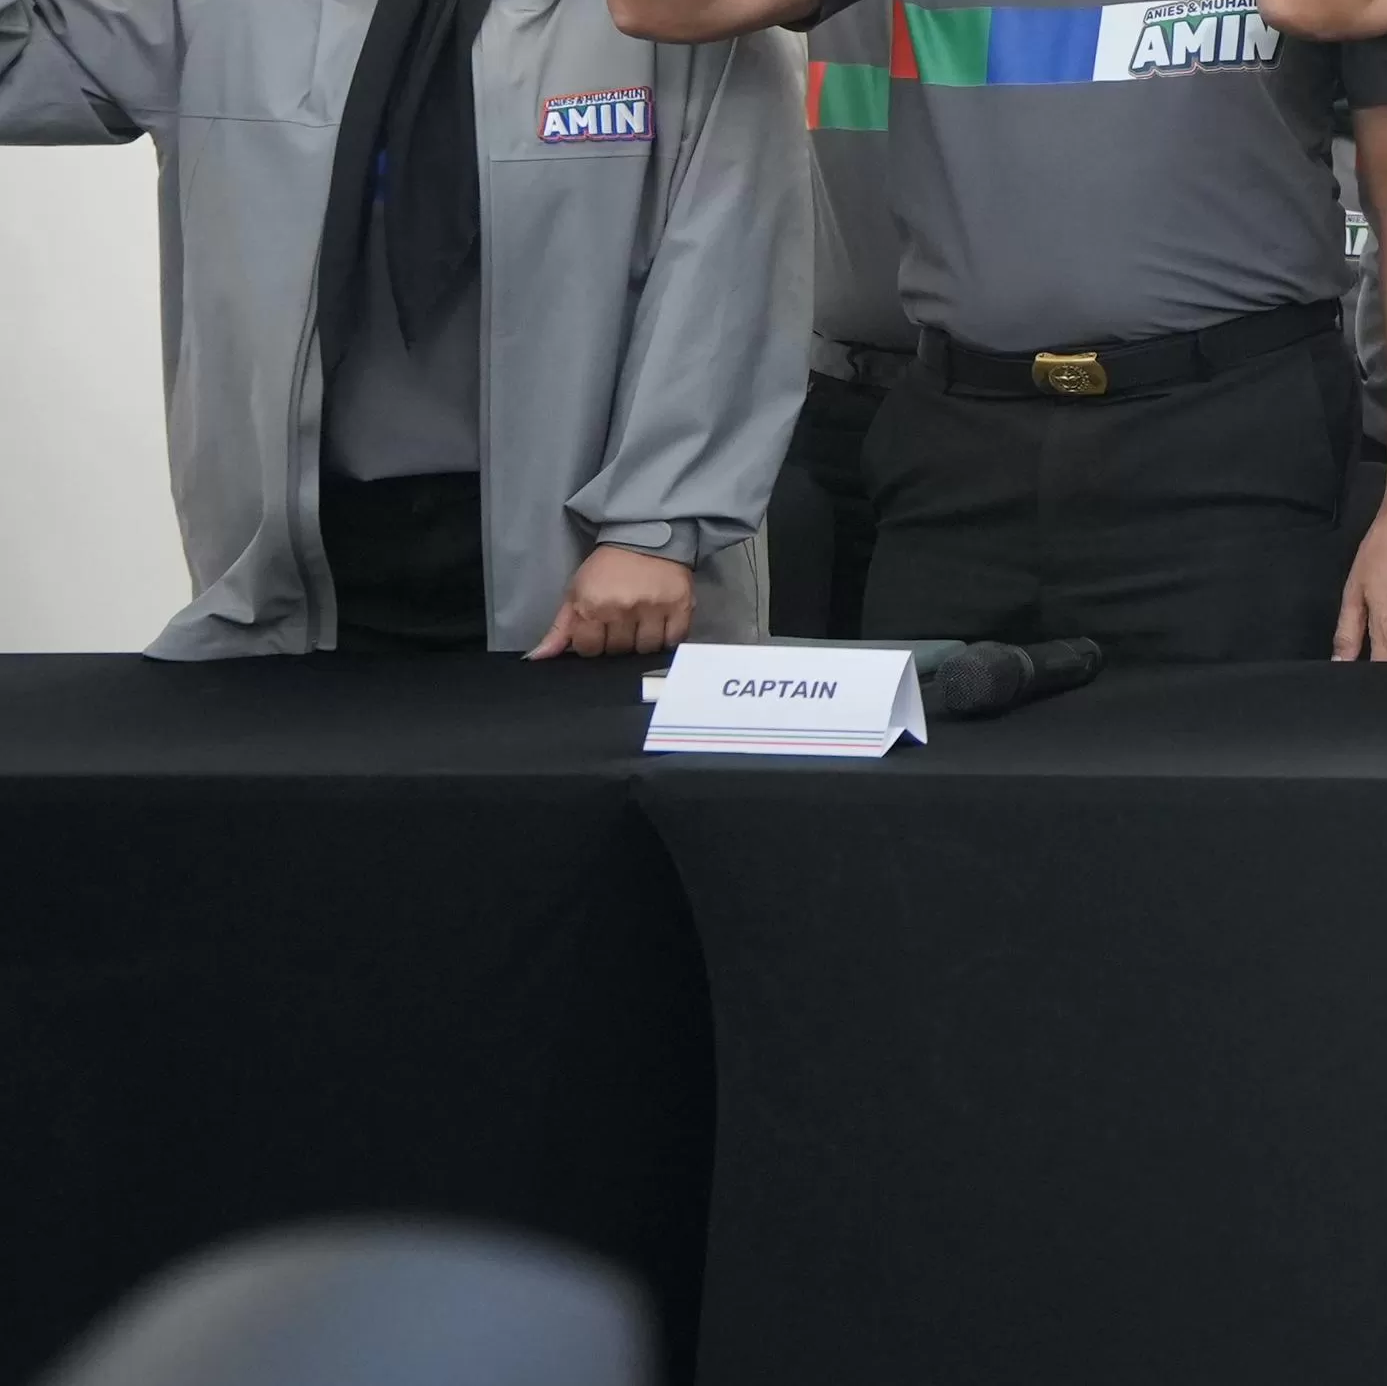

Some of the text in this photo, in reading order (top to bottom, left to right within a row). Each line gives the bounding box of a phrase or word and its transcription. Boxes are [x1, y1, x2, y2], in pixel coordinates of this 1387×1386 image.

[1146, 4, 1184, 21] ANIES
[1188, 2, 1197, 13] &
[1132, 13, 1280, 70] AMIN
[543, 101, 646, 136] AMIN
[722, 678, 837, 700] CAPTAIN
